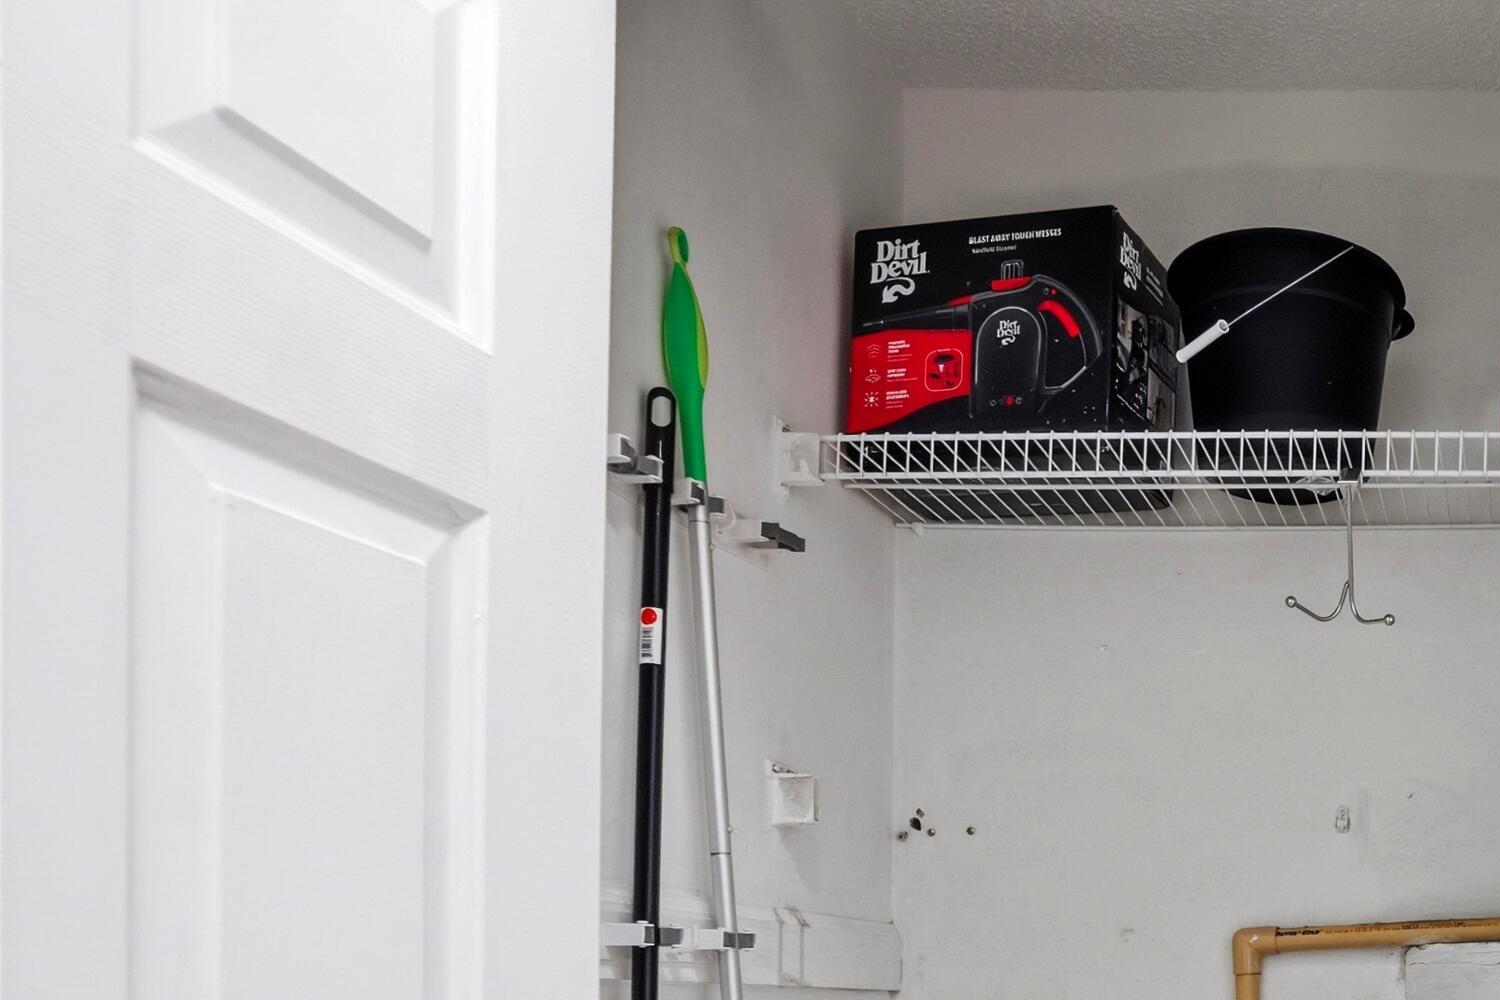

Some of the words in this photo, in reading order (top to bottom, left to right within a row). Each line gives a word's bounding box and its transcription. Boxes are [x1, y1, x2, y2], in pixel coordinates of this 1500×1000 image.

[876, 238, 920, 262] Dirt
[968, 235, 990, 245] BLAST
[870, 251, 928, 284] Devil
